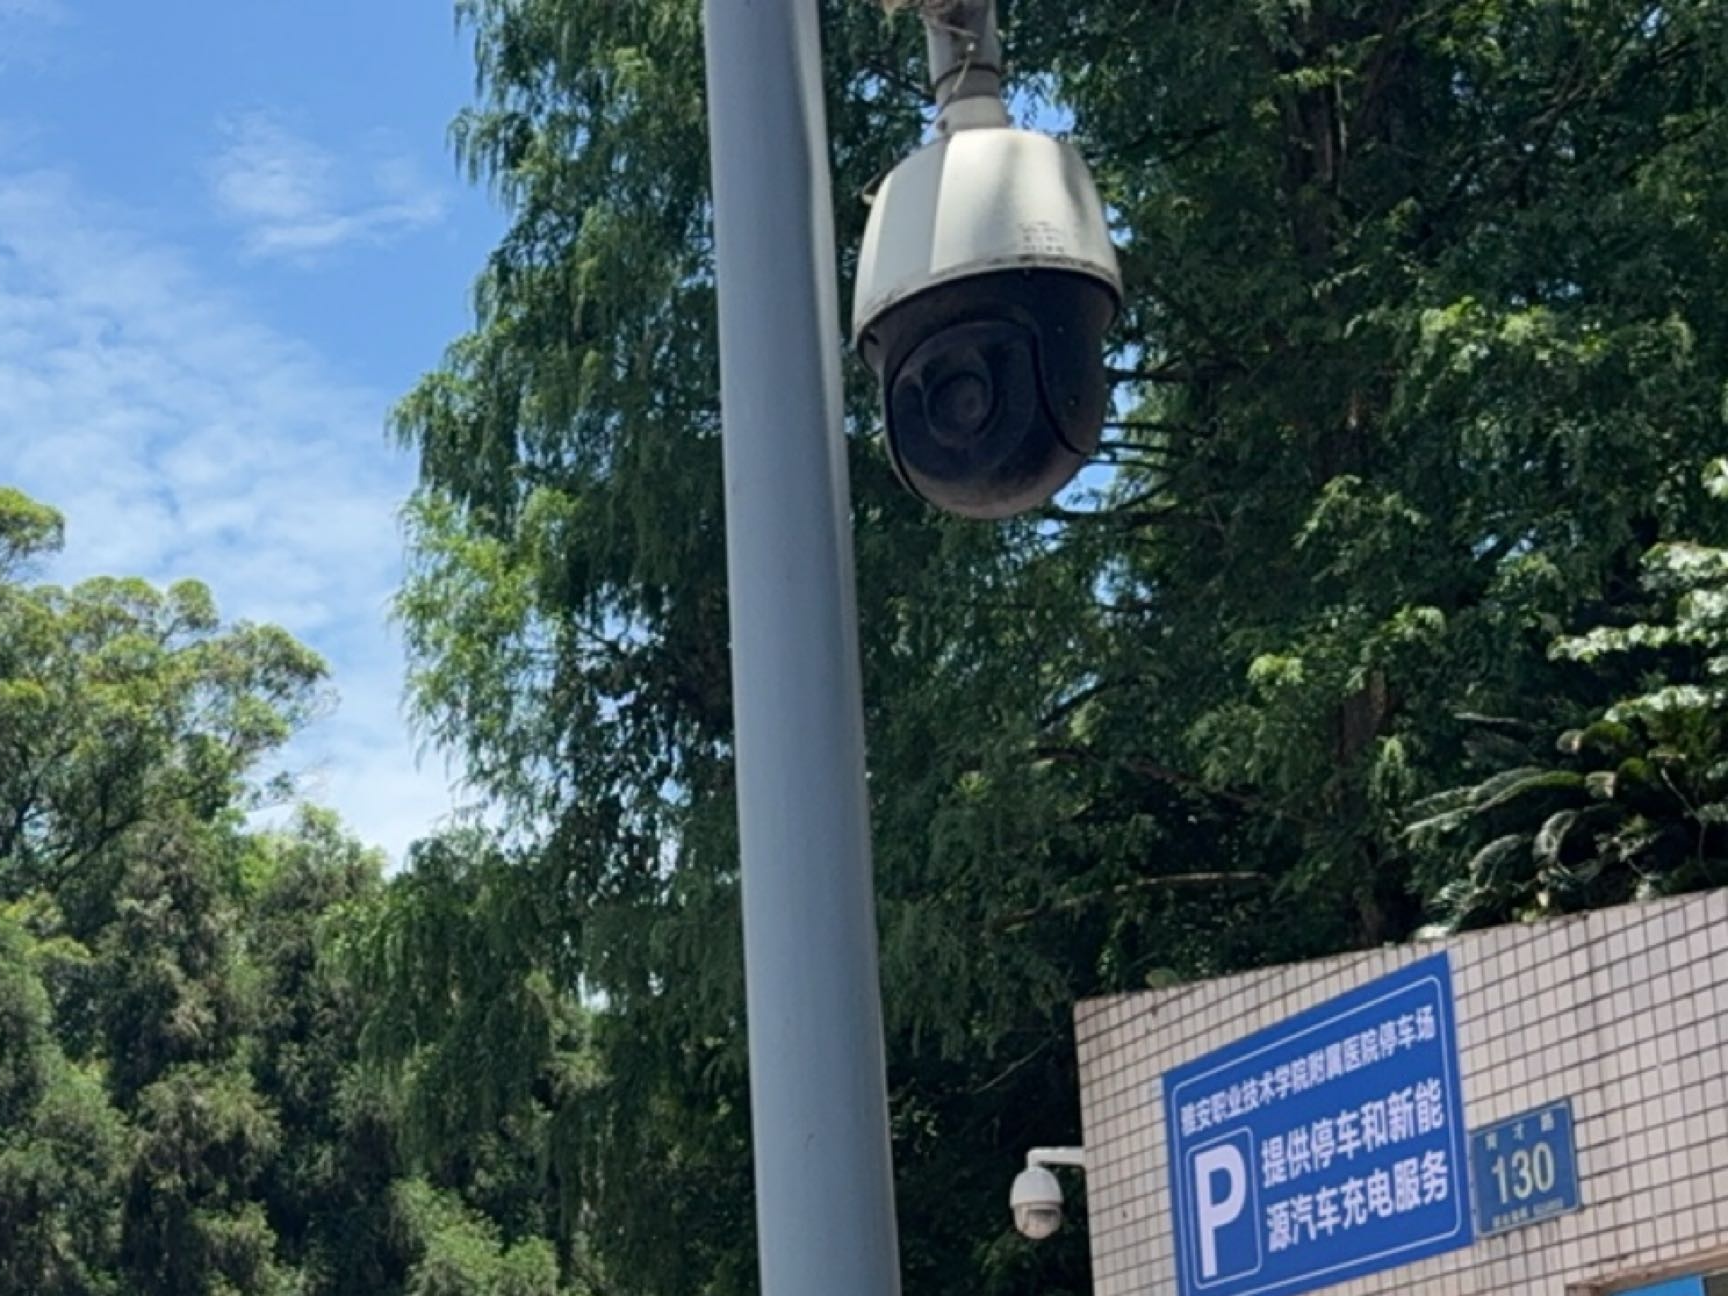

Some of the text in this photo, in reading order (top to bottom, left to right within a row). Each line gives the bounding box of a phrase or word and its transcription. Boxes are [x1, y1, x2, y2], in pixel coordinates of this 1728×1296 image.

[1180, 1004, 1436, 1137] 雅安职业技术学院附属医院停车场
[1261, 1078, 1445, 1189] 提供停车和新能
[1491, 1142, 1555, 1204] 130
[1194, 1144, 1247, 1279] P
[1266, 1149, 1450, 1254] 源汽车充电服务
